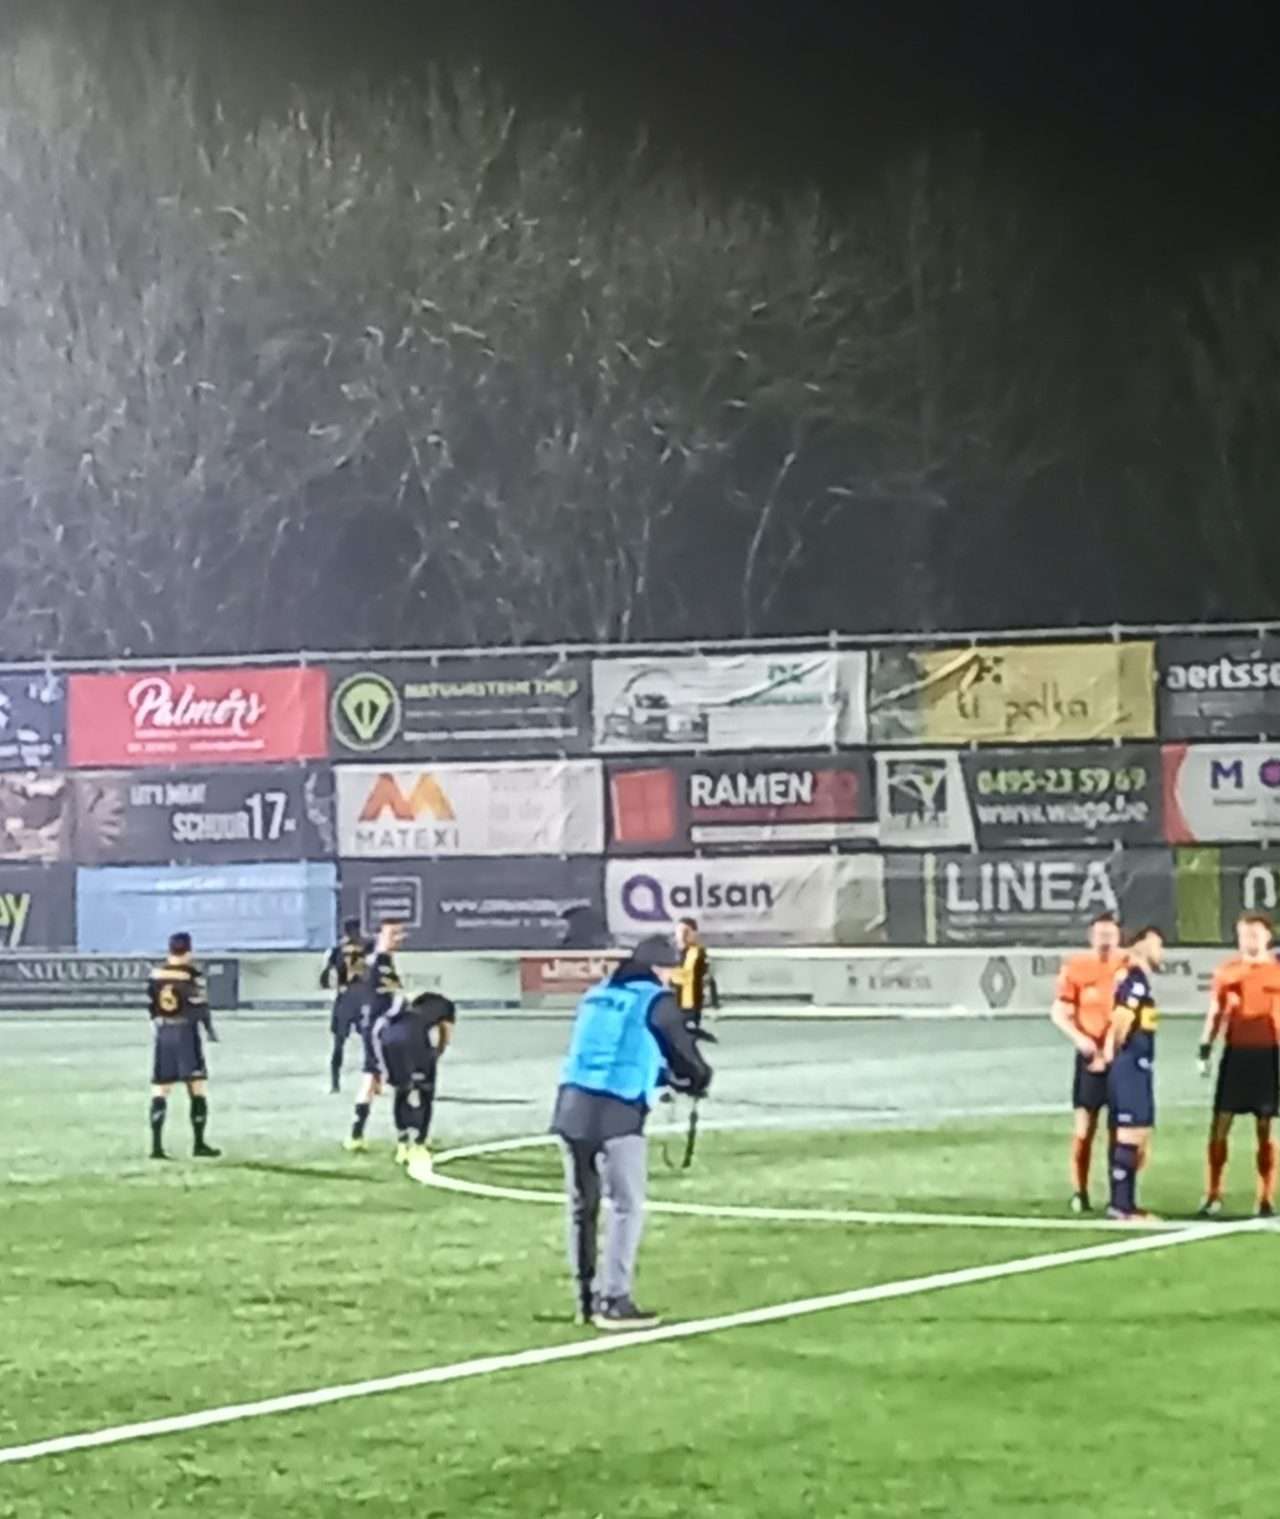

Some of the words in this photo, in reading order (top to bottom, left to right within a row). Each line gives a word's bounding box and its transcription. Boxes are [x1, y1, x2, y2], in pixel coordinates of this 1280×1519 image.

[690, 771, 813, 807] RAMEN
[355, 828, 460, 849] MATEXI
[669, 872, 773, 910] alsan
[945, 860, 1118, 912] LINEA
